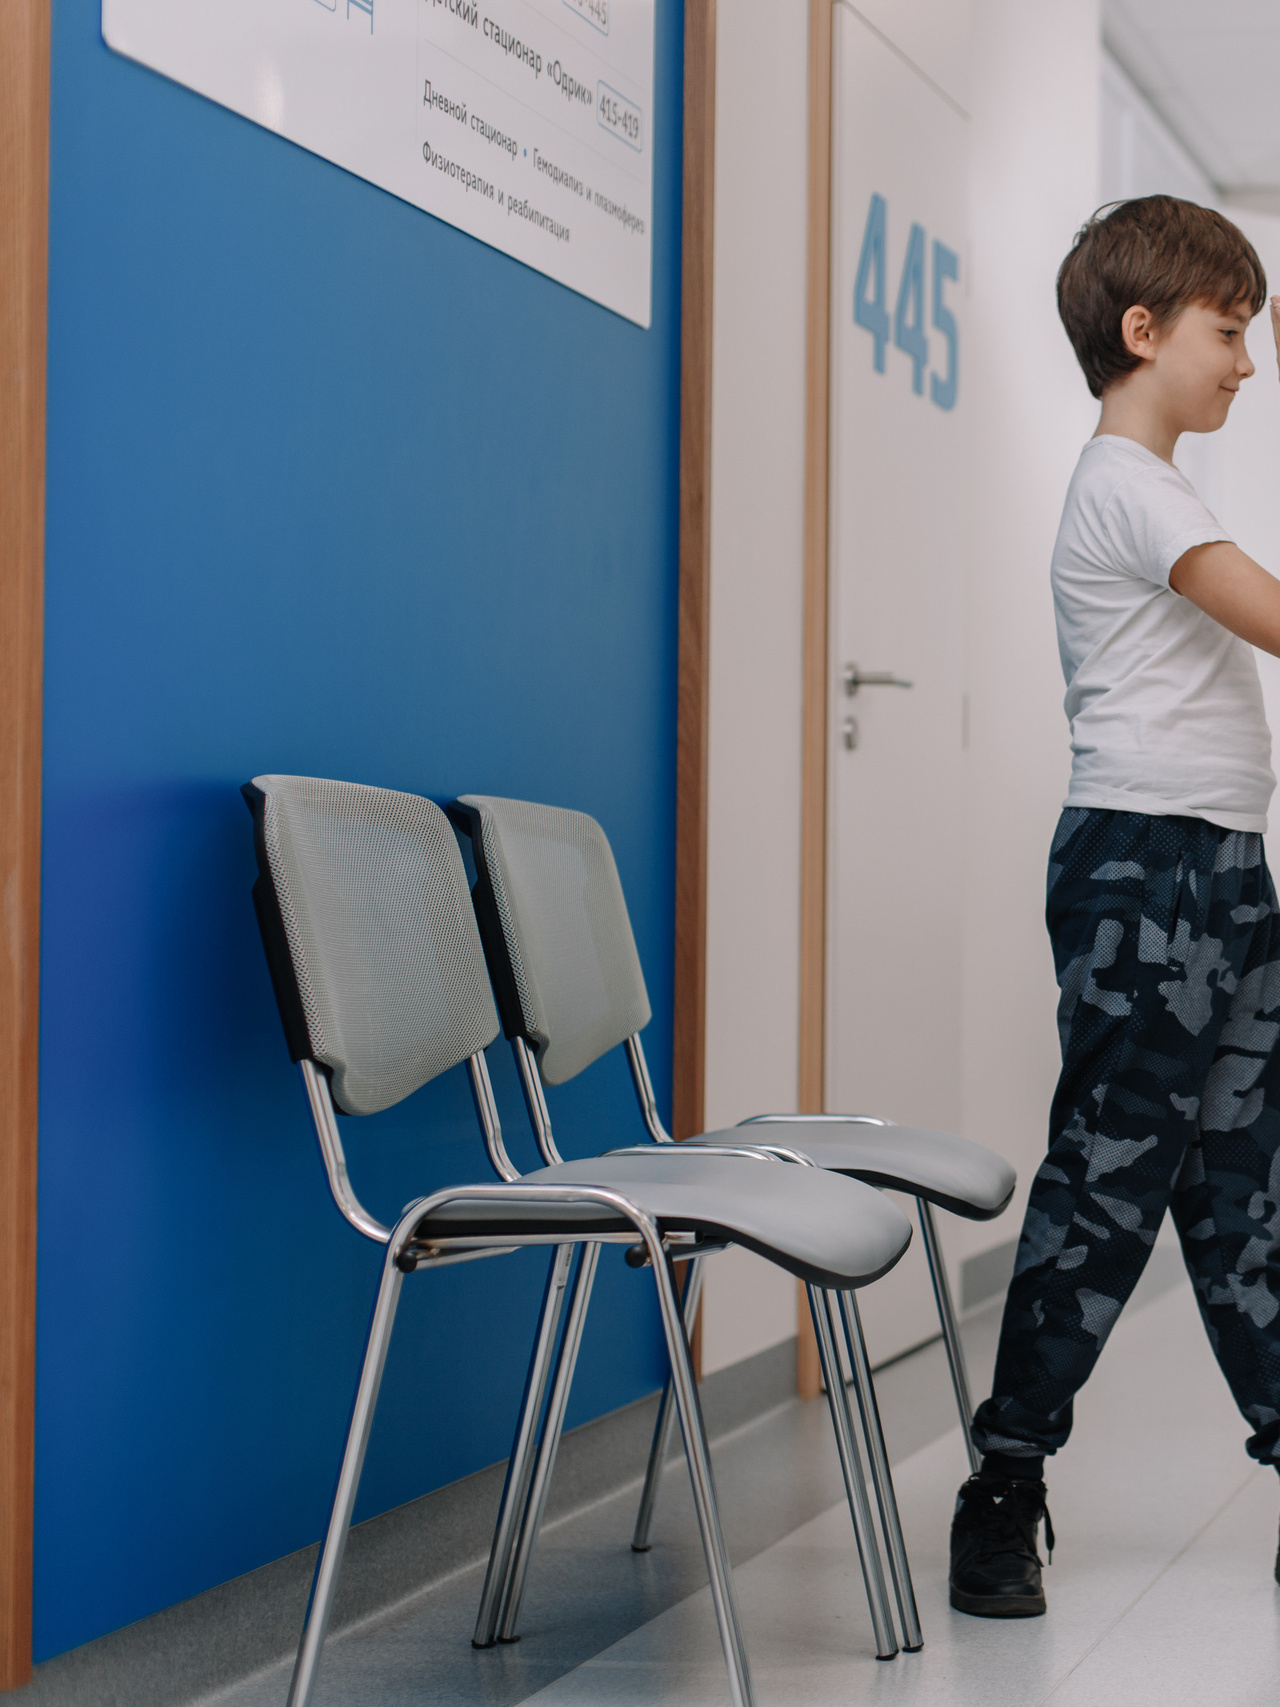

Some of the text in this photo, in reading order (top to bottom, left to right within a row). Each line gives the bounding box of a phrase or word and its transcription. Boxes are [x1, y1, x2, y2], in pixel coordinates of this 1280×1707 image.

[483, 17, 542, 79] стационар
[546, 60, 593, 105] «Одрик»
[423, 79, 468, 125] Дневной
[470, 114, 518, 161] стационар
[532, 147, 584, 197] Гемодиализ
[586, 186, 592, 203] и
[600, 94, 640, 139] 415-419
[422, 141, 570, 243] Физиотерапия и реабилитация
[853, 191, 958, 412] 445
